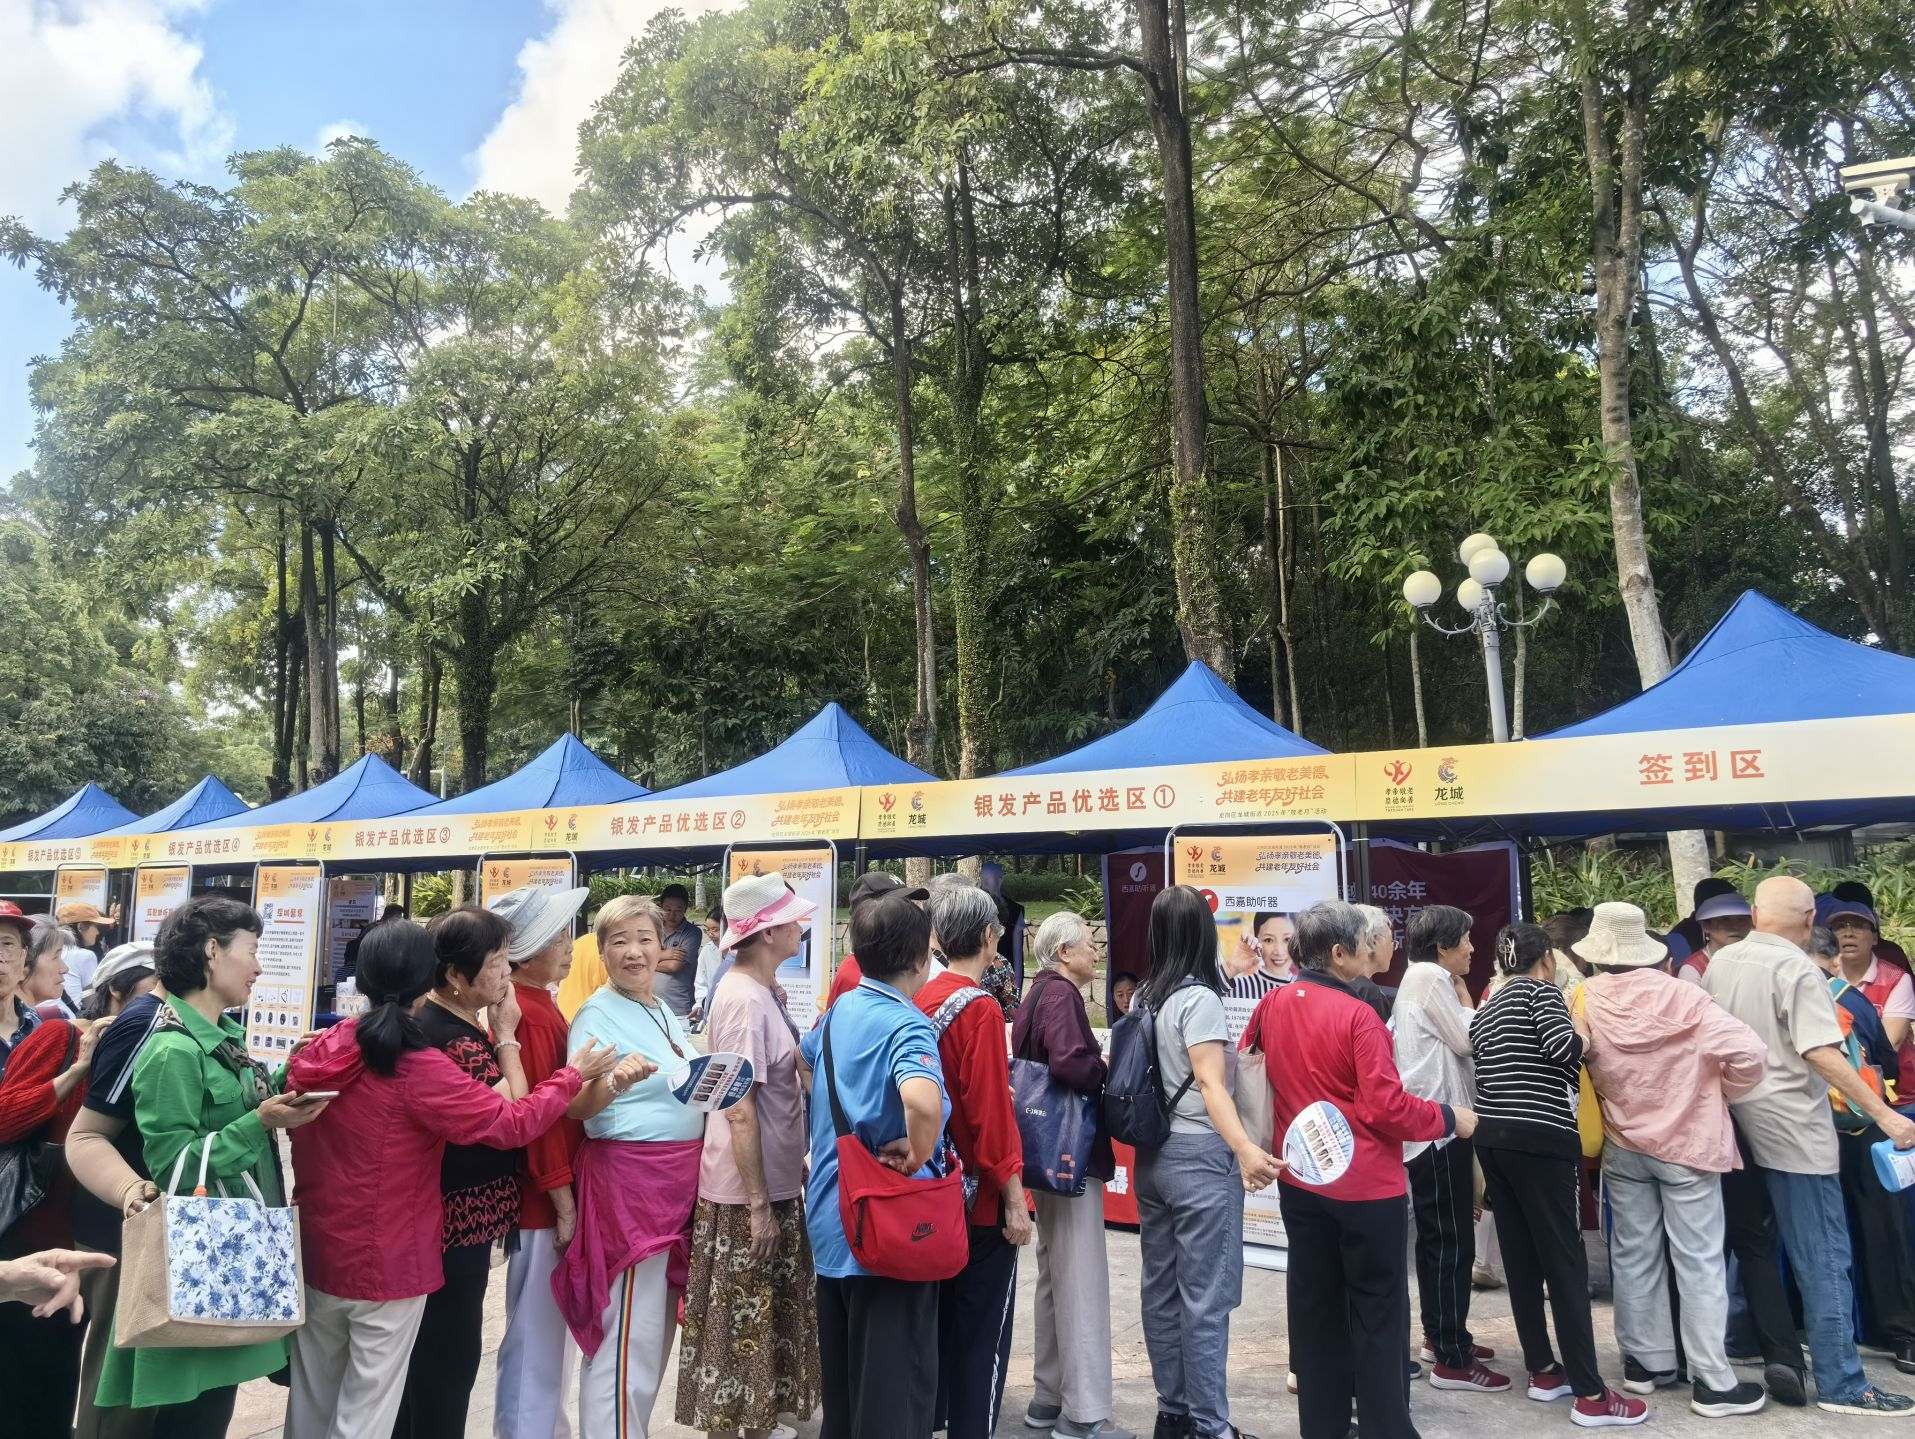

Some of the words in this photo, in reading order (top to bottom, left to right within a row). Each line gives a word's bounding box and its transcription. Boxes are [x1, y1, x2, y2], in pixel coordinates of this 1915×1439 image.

[1638, 749, 1765, 785] 签到区
[974, 784, 1175, 818] 银发产品优选区①
[1216, 785, 1325, 807] 共建老年友好社会
[1435, 786, 1464, 801] 龙城
[611, 810, 746, 835] 银发产品优选区②
[908, 813, 927, 825] 龙城
[355, 826, 451, 848] 银发产品优选区③
[168, 837, 240, 856] 银发产品优选区④
[1209, 864, 1226, 873] 龙城
[1255, 862, 1320, 874] 共建老年友好社会
[1122, 884, 1156, 893] 西嘉助听器
[1225, 896, 1278, 908] 西嘉助听器
[915, 1222, 933, 1232] NIKE
